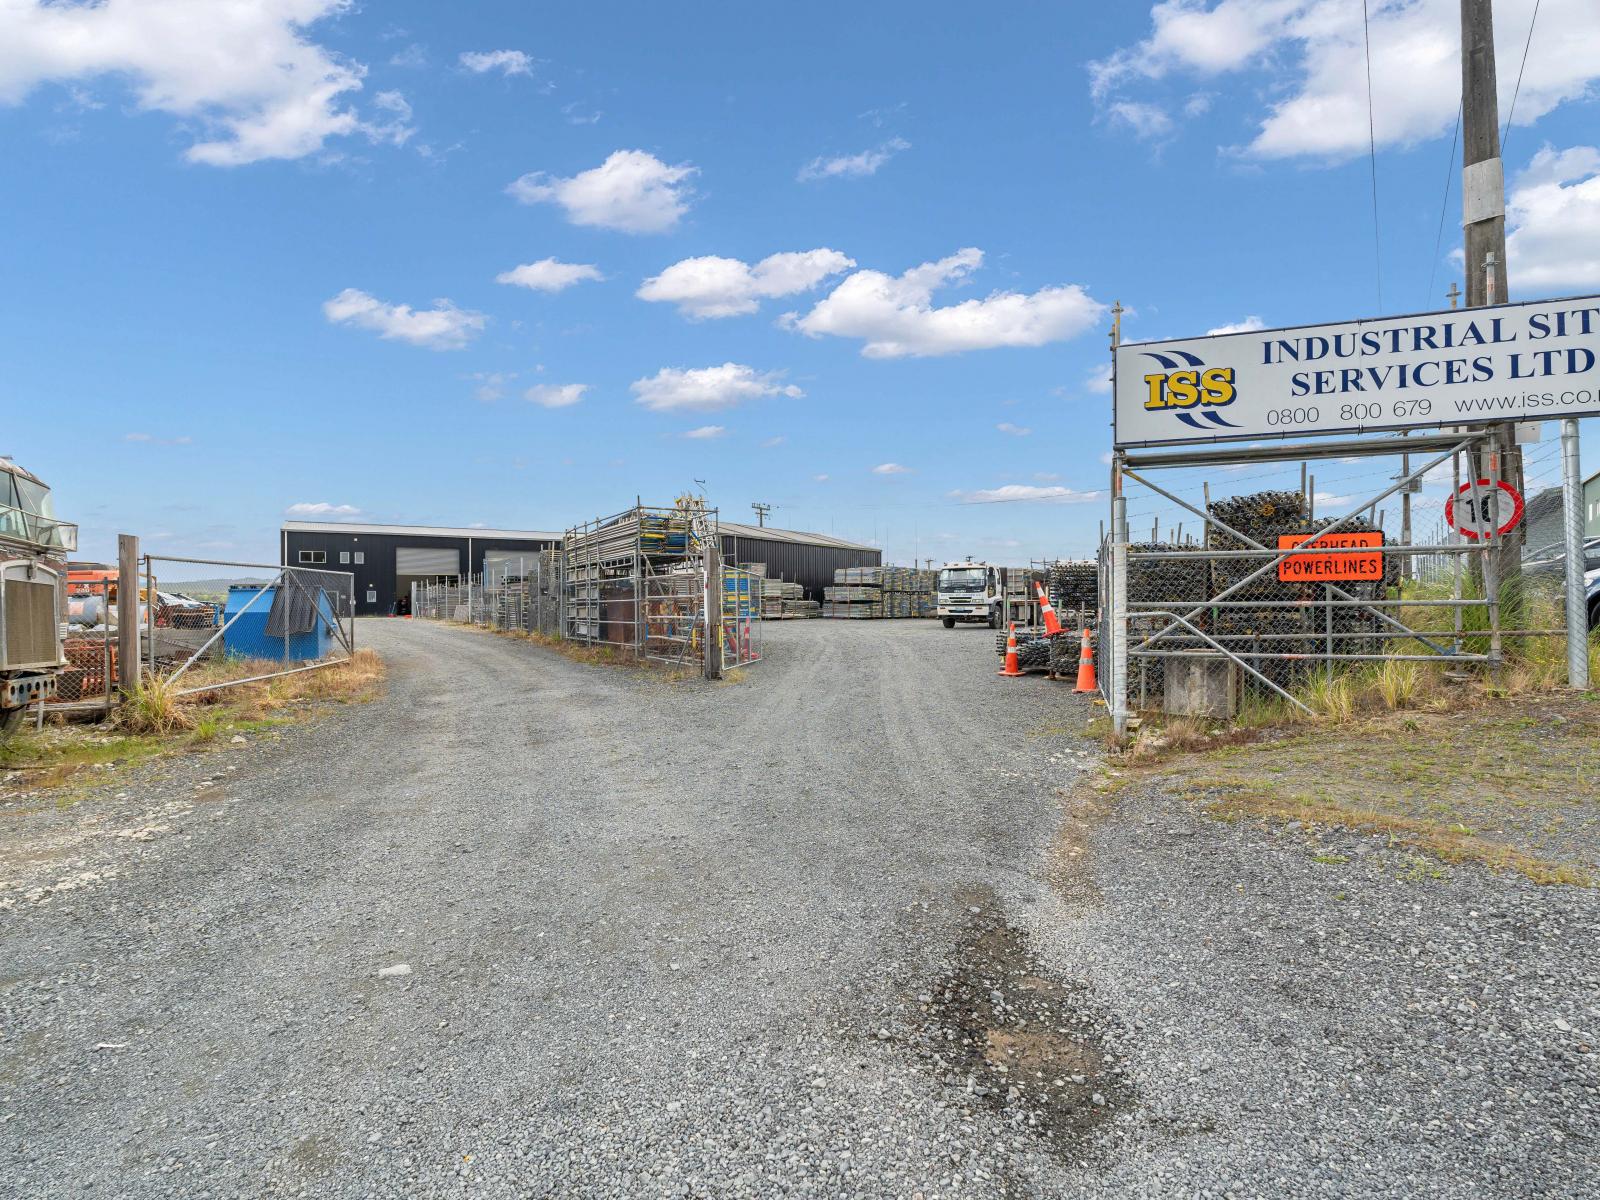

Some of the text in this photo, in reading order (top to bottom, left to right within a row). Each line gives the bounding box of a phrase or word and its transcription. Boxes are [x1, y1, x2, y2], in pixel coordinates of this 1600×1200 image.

[1262, 318, 1517, 365] INDUSTRIAL
[1144, 367, 1237, 411] ISS
[1291, 348, 1596, 397] SERVICES LTD
[1267, 390, 1600, 425] 0800 800 679 www.iss.co.
[1283, 559, 1377, 575] POWERLINES
